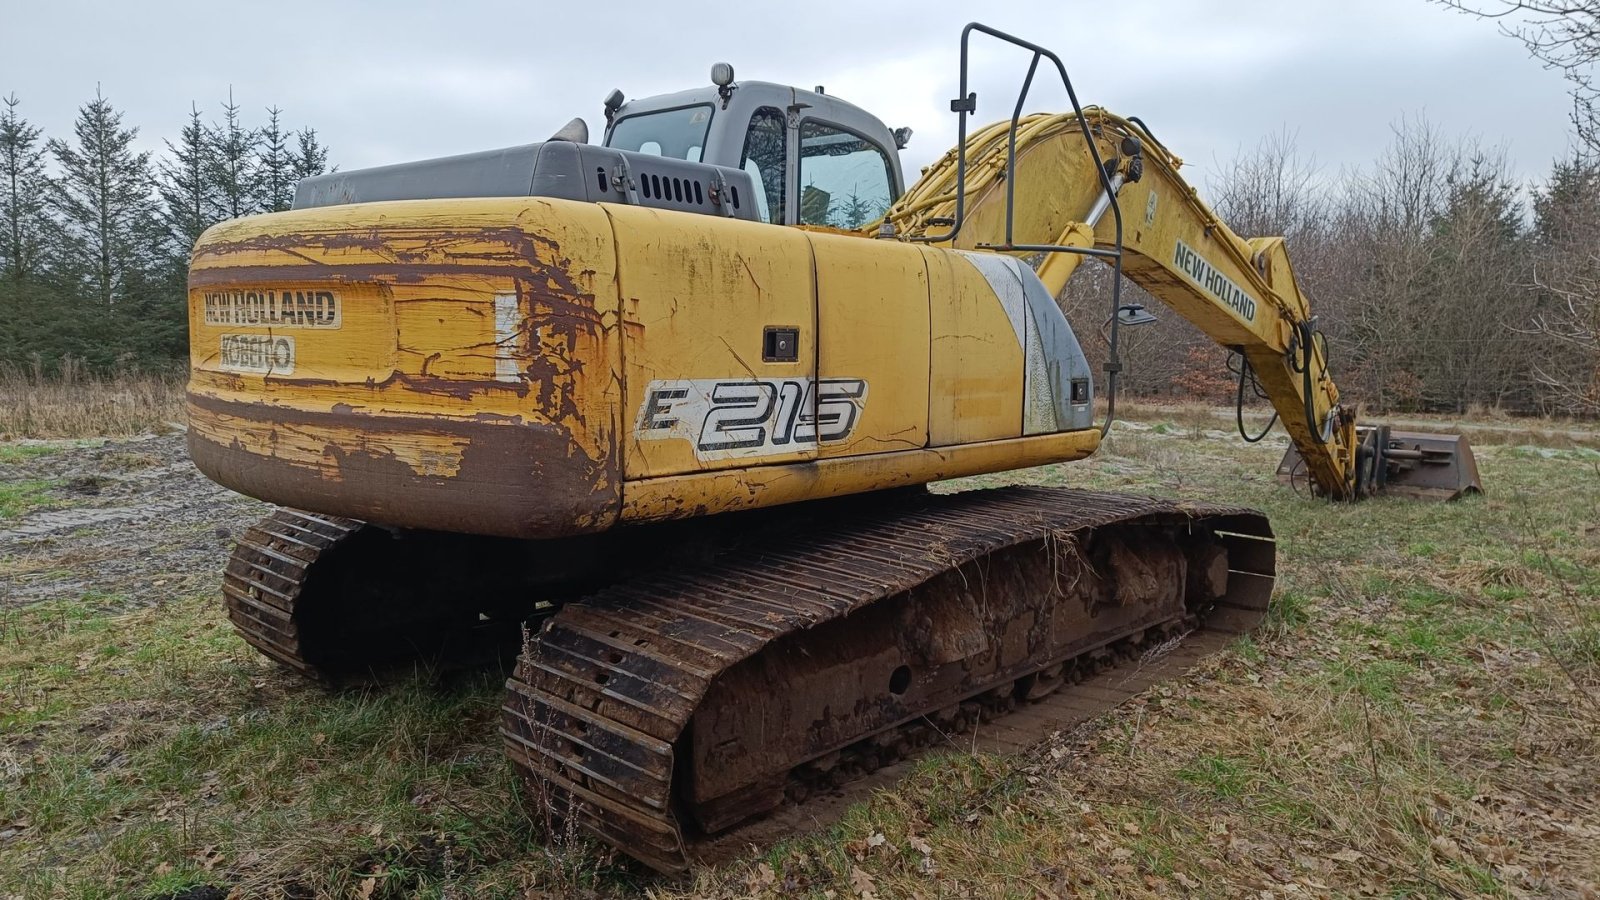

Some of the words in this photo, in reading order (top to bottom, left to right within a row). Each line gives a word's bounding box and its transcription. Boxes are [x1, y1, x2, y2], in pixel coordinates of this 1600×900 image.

[234, 289, 336, 326] HOLLAND
[1174, 242, 1205, 282] NEW
[1205, 267, 1256, 322] HOLLAND
